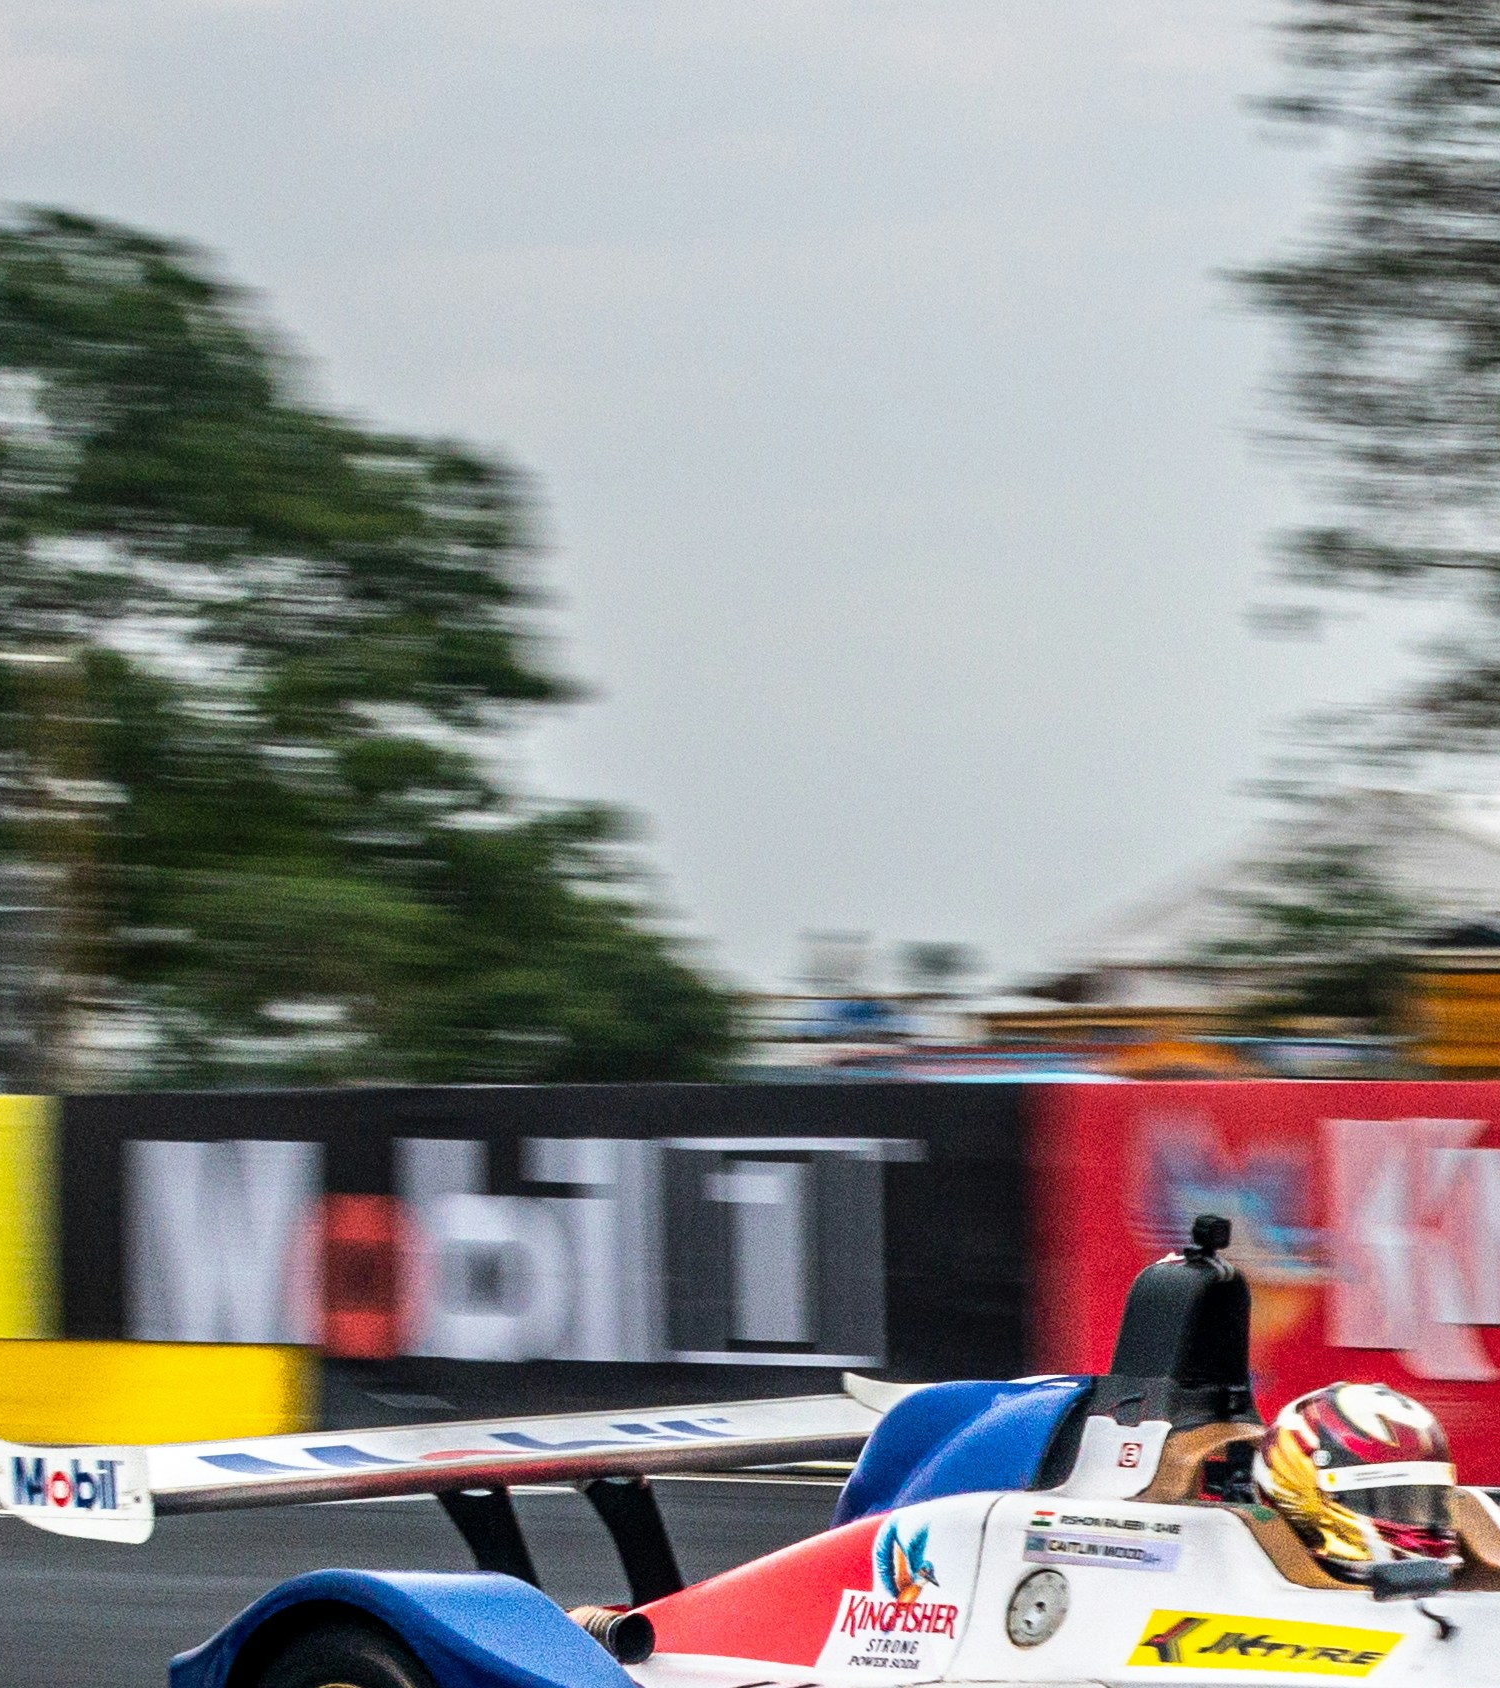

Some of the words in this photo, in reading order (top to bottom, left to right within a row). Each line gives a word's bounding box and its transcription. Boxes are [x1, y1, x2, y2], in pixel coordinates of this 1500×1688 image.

[122, 1138, 665, 1366] Mobil
[10, 1456, 124, 1510] Mobil
[840, 1594, 959, 1639] KINGFISHER
[866, 1638, 920, 1655] STRONG
